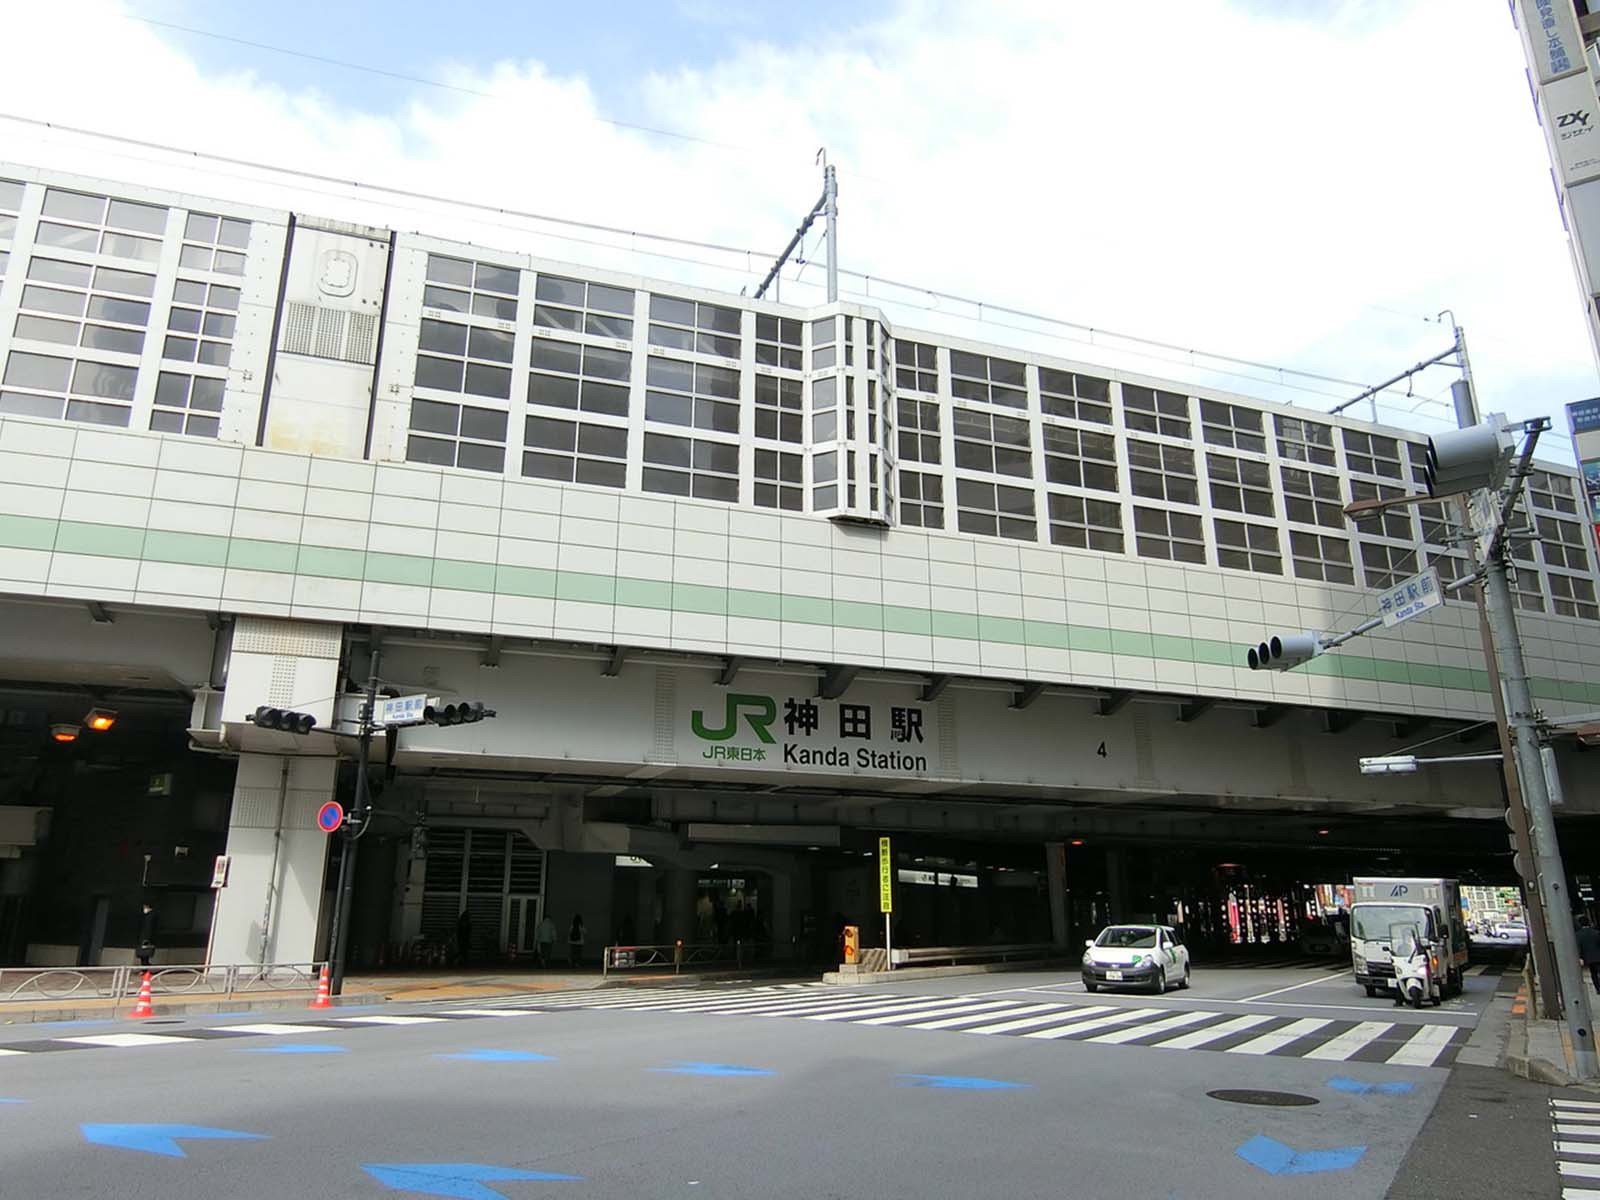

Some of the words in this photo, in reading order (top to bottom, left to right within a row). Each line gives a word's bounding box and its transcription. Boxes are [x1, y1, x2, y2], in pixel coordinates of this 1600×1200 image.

[1380, 575, 1434, 612] 神田駅前
[691, 693, 777, 744] JR
[783, 697, 924, 744] 神田駅
[702, 745, 768, 762] JR東日本
[783, 743, 850, 767] Kanda
[856, 747, 927, 772] Station
[1096, 740, 1107, 759] 4
